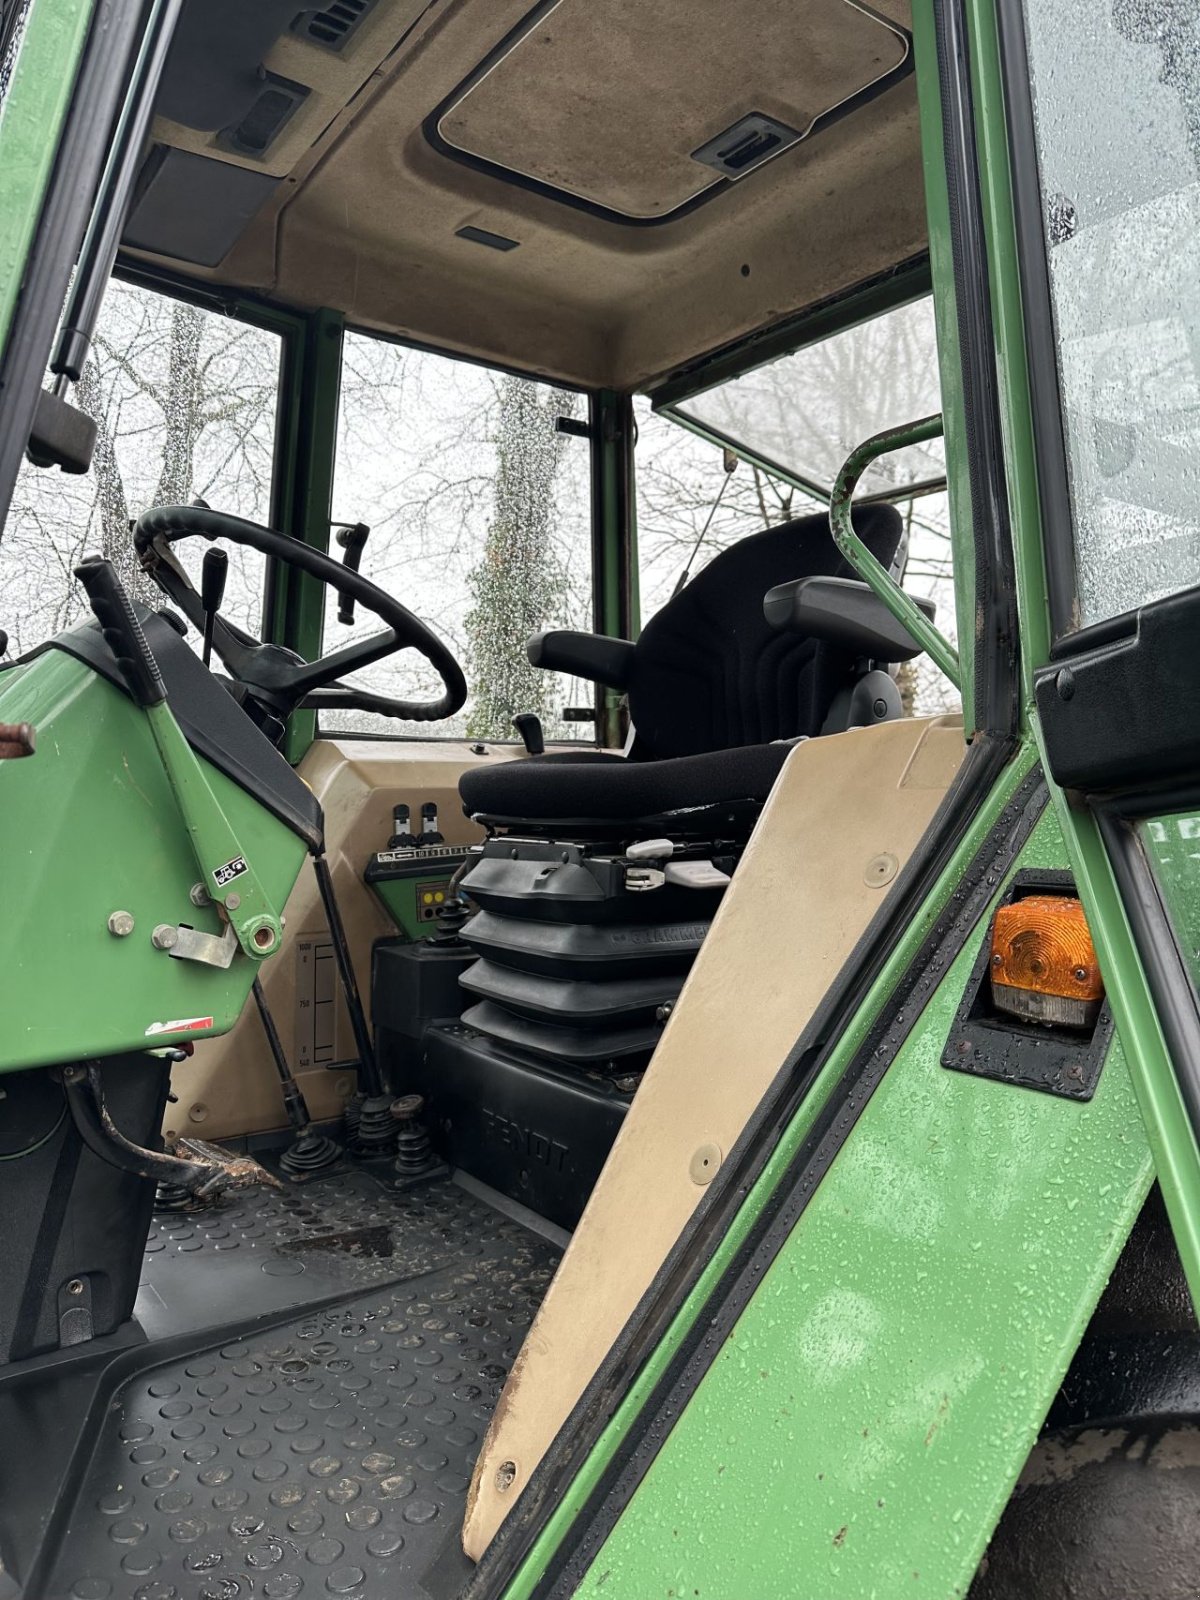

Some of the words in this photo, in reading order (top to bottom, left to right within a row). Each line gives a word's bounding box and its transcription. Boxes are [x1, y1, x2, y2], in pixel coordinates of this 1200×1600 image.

[299, 943, 311, 951] 1000
[299, 1000, 310, 1008] 750
[299, 1059, 310, 1067] 540
[481, 1107, 570, 1173] FENDT
